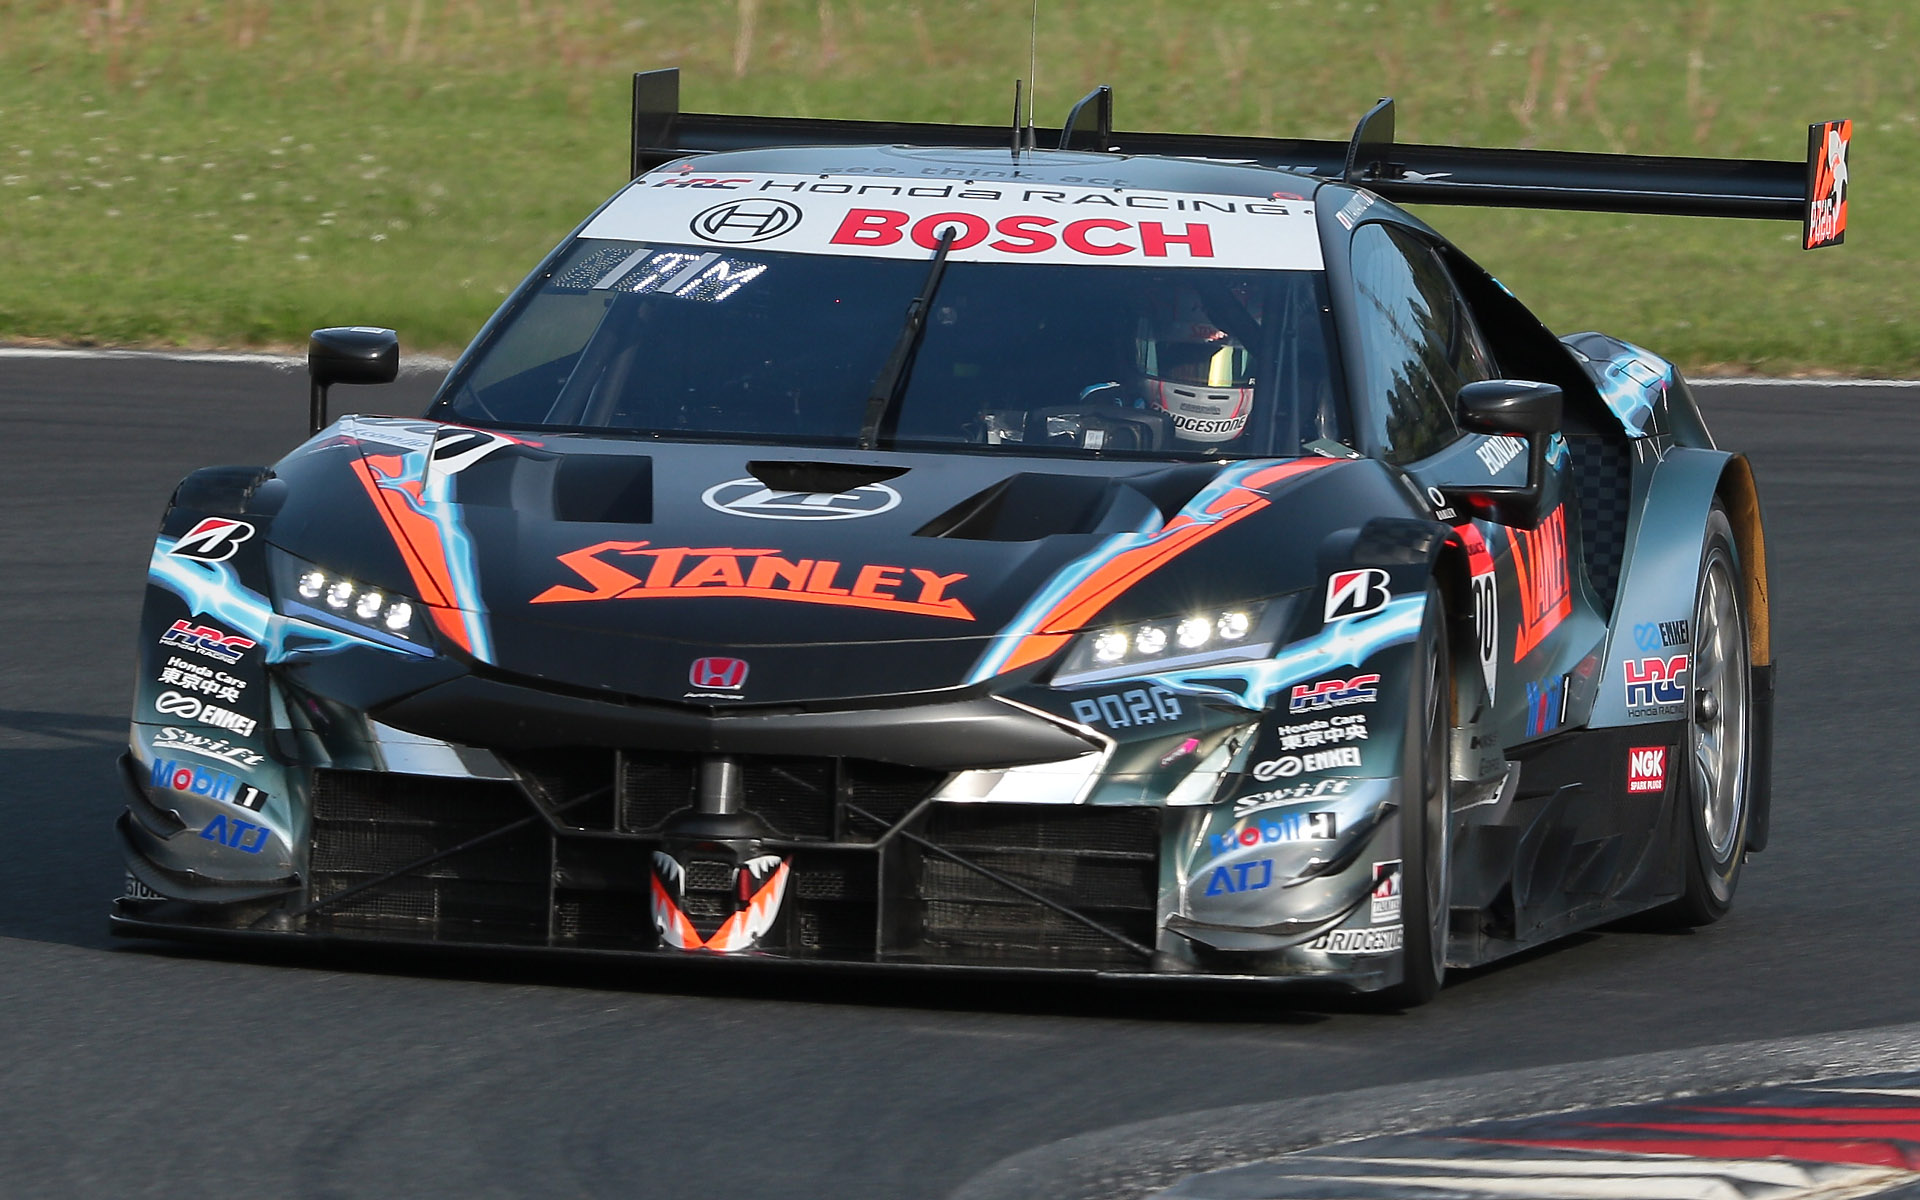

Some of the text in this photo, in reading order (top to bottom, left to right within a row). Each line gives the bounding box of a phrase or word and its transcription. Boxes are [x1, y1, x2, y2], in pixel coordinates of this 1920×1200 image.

[759, 180, 1002, 200] Honda
[1022, 190, 1290, 216] RACING
[829, 208, 1215, 258] BOSCH
[529, 541, 976, 621] STANLEY
[161, 619, 256, 661] HRC
[1658, 620, 1690, 647] ENKEI
[157, 667, 241, 703] 東京中央
[168, 656, 248, 689] Honda Cars
[1623, 654, 1689, 707] HRC
[1289, 674, 1381, 709] HRC
[198, 704, 258, 737] ENKEI
[1278, 714, 1366, 736] Honda Cars
[1628, 706, 1658, 718] Honda
[1279, 724, 1369, 751] 東京中央
[1302, 746, 1362, 771] ENKEI
[1631, 749, 1663, 778] NGK
[151, 758, 236, 801] Mobil
[1630, 779, 1662, 791] SPARK PLUGS
[200, 814, 273, 854] ATJ
[1208, 813, 1300, 857] Mobil
[1204, 858, 1275, 897] ATJ
